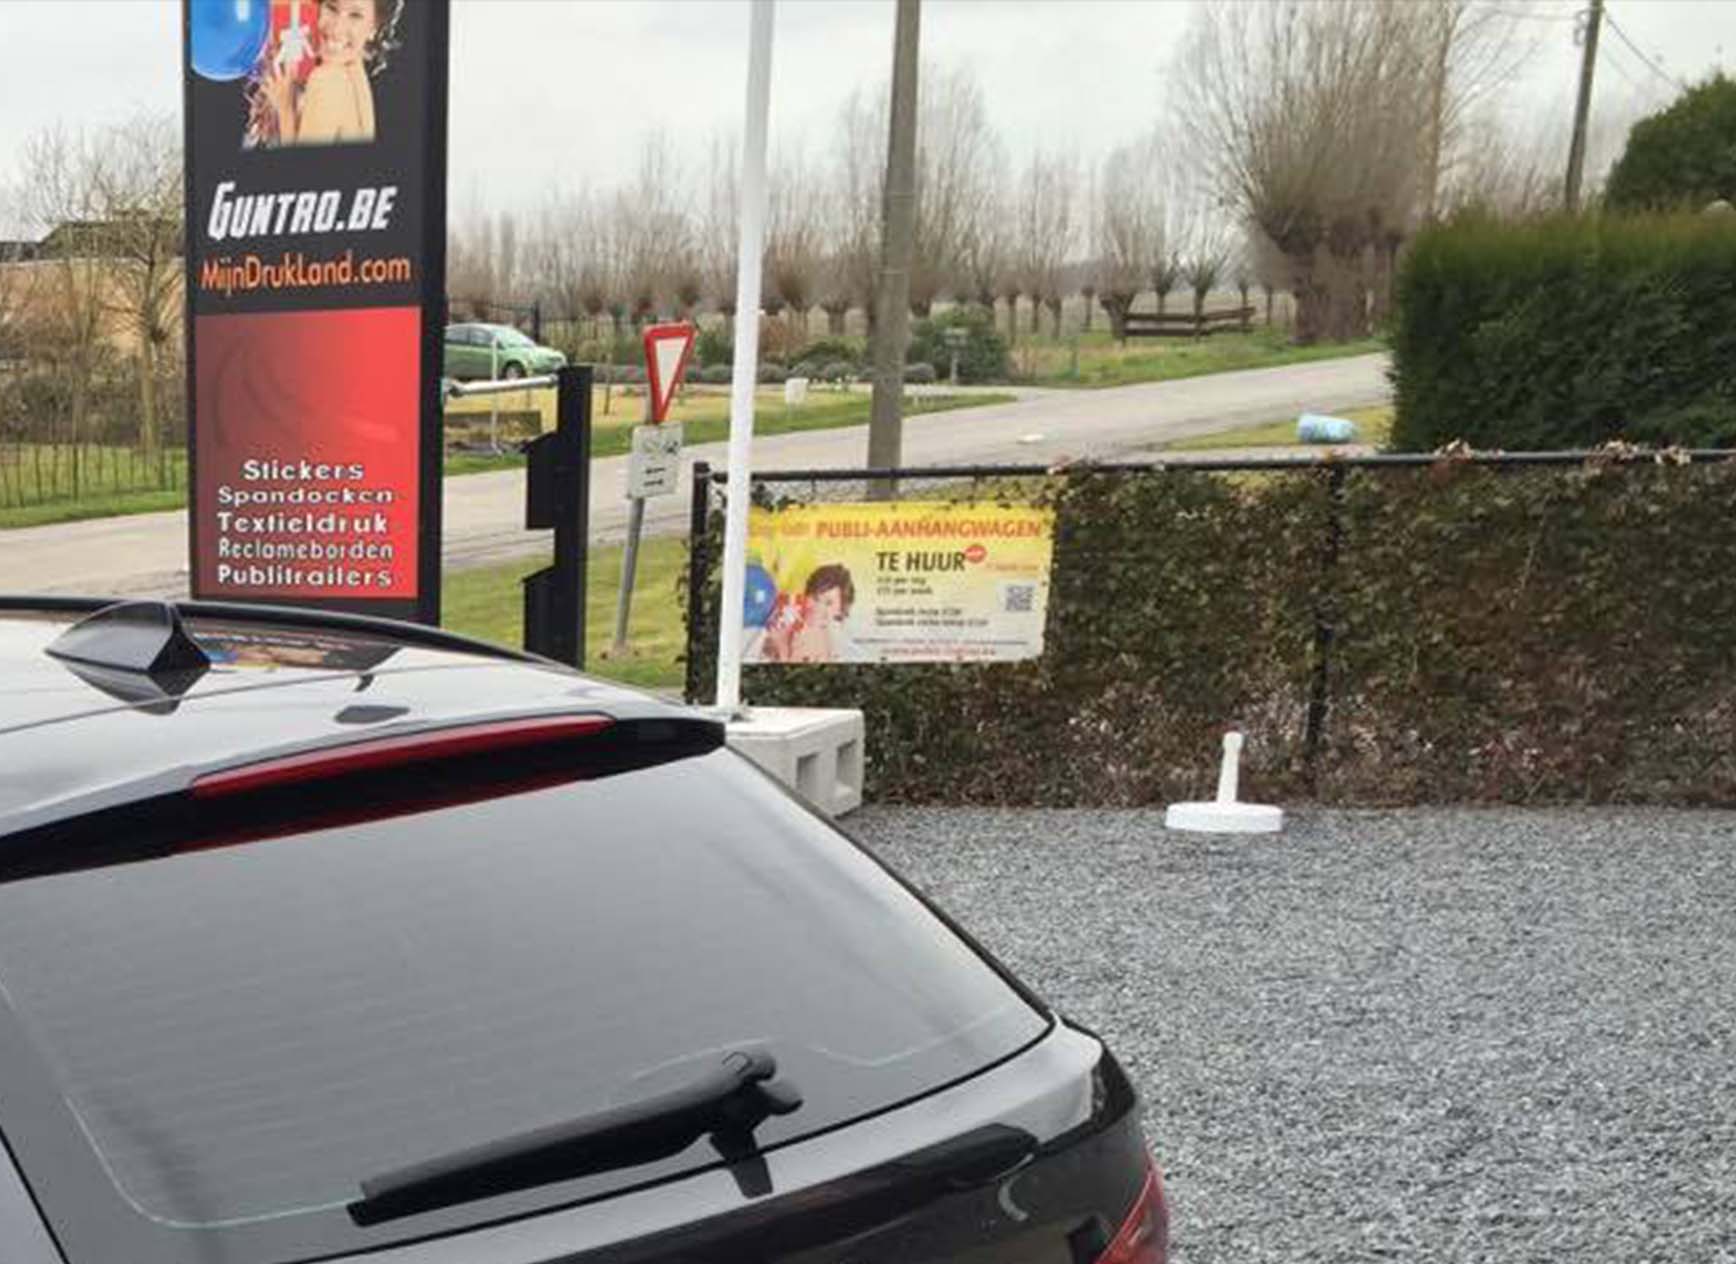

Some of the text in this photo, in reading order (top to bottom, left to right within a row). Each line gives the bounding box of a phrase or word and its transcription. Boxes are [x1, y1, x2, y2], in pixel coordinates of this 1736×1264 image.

[200, 249, 411, 297] MijnDrukLand.com
[243, 460, 364, 480] Stickers
[217, 486, 393, 506] Spandoeken
[217, 512, 389, 533] Textieldruk
[816, 519, 1041, 538] PUBLI-AANHANGWAGEN
[217, 537, 394, 559] Reclameborden
[875, 551, 899, 571] TE
[906, 551, 966, 571] HUUR
[217, 564, 394, 586] Publitrailers
